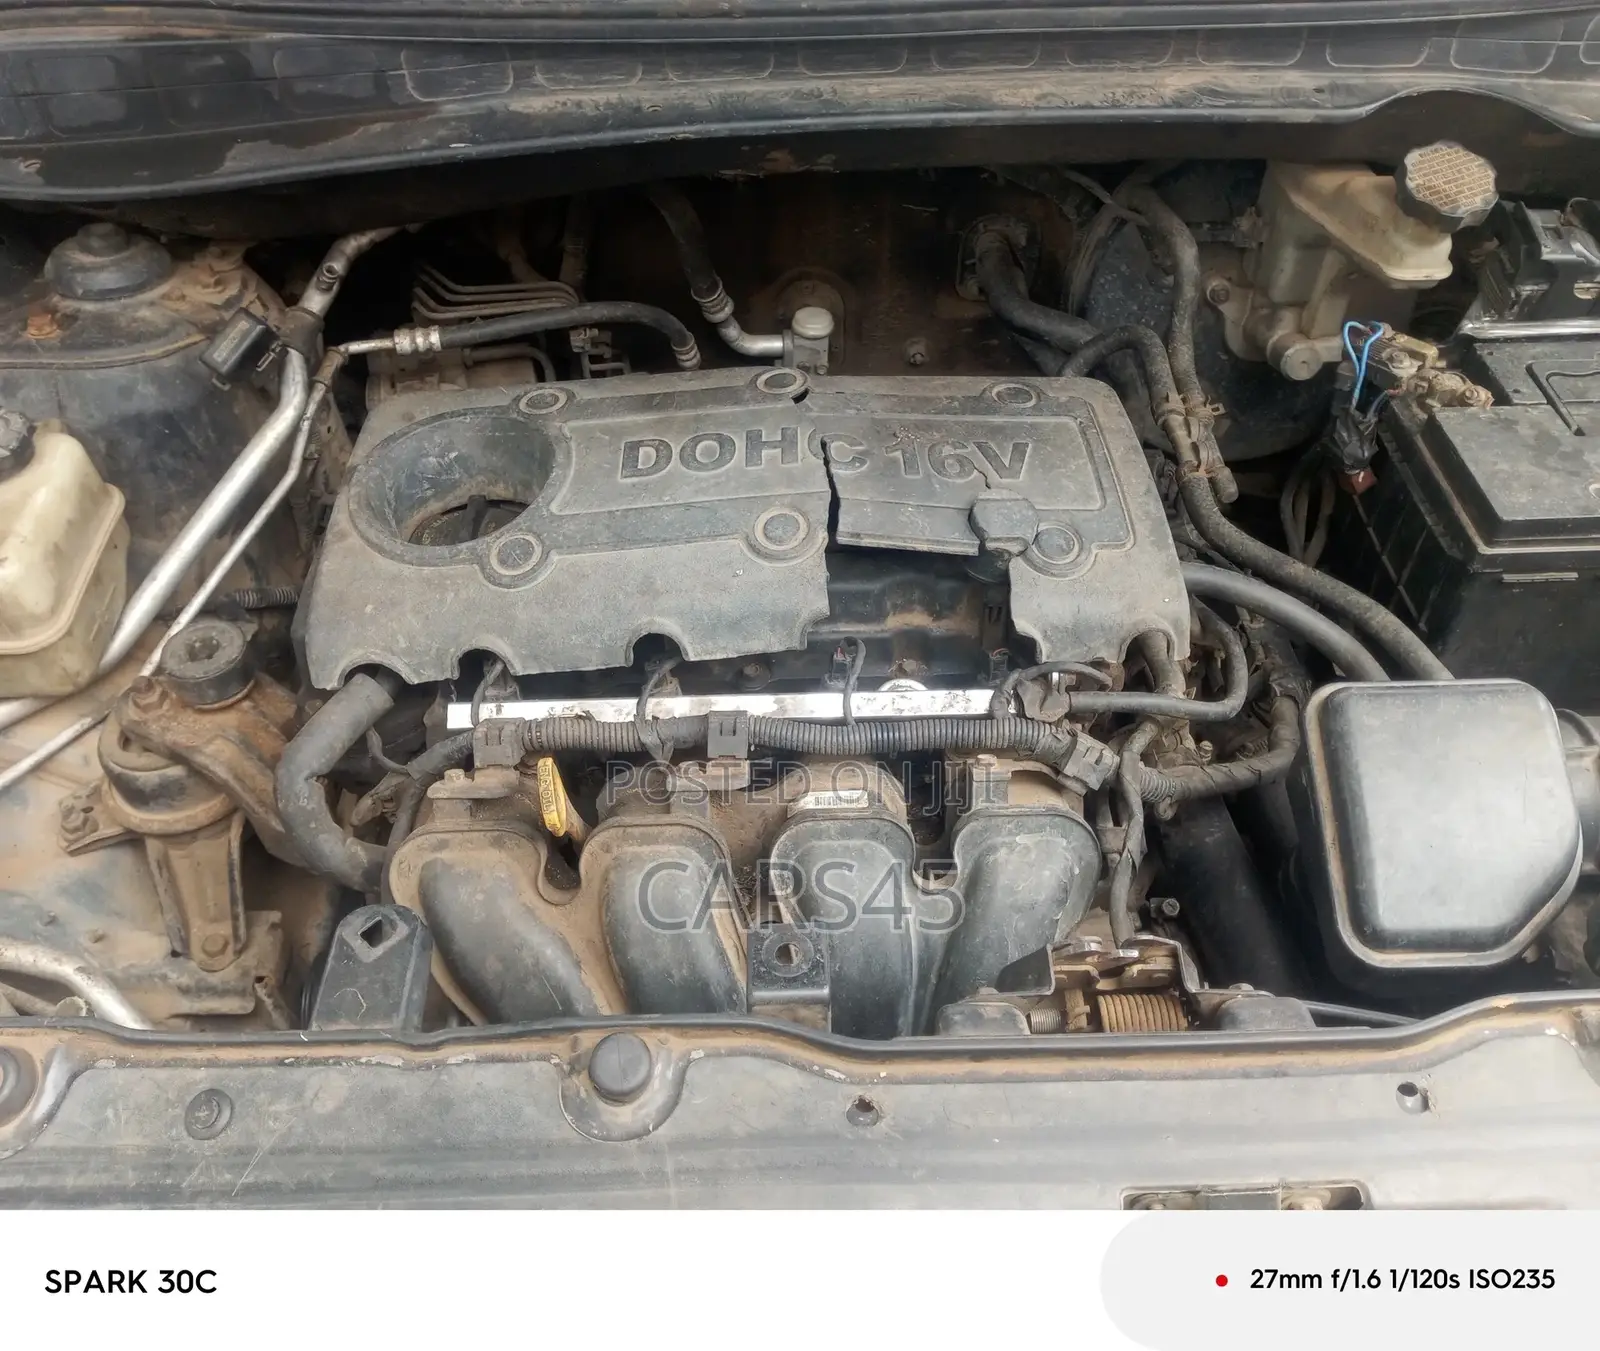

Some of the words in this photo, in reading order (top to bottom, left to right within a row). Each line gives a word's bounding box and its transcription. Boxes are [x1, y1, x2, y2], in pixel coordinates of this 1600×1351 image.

[619, 425, 870, 480] DOHC
[885, 436, 1032, 482] 16V
[541, 790, 553, 812] OIL
